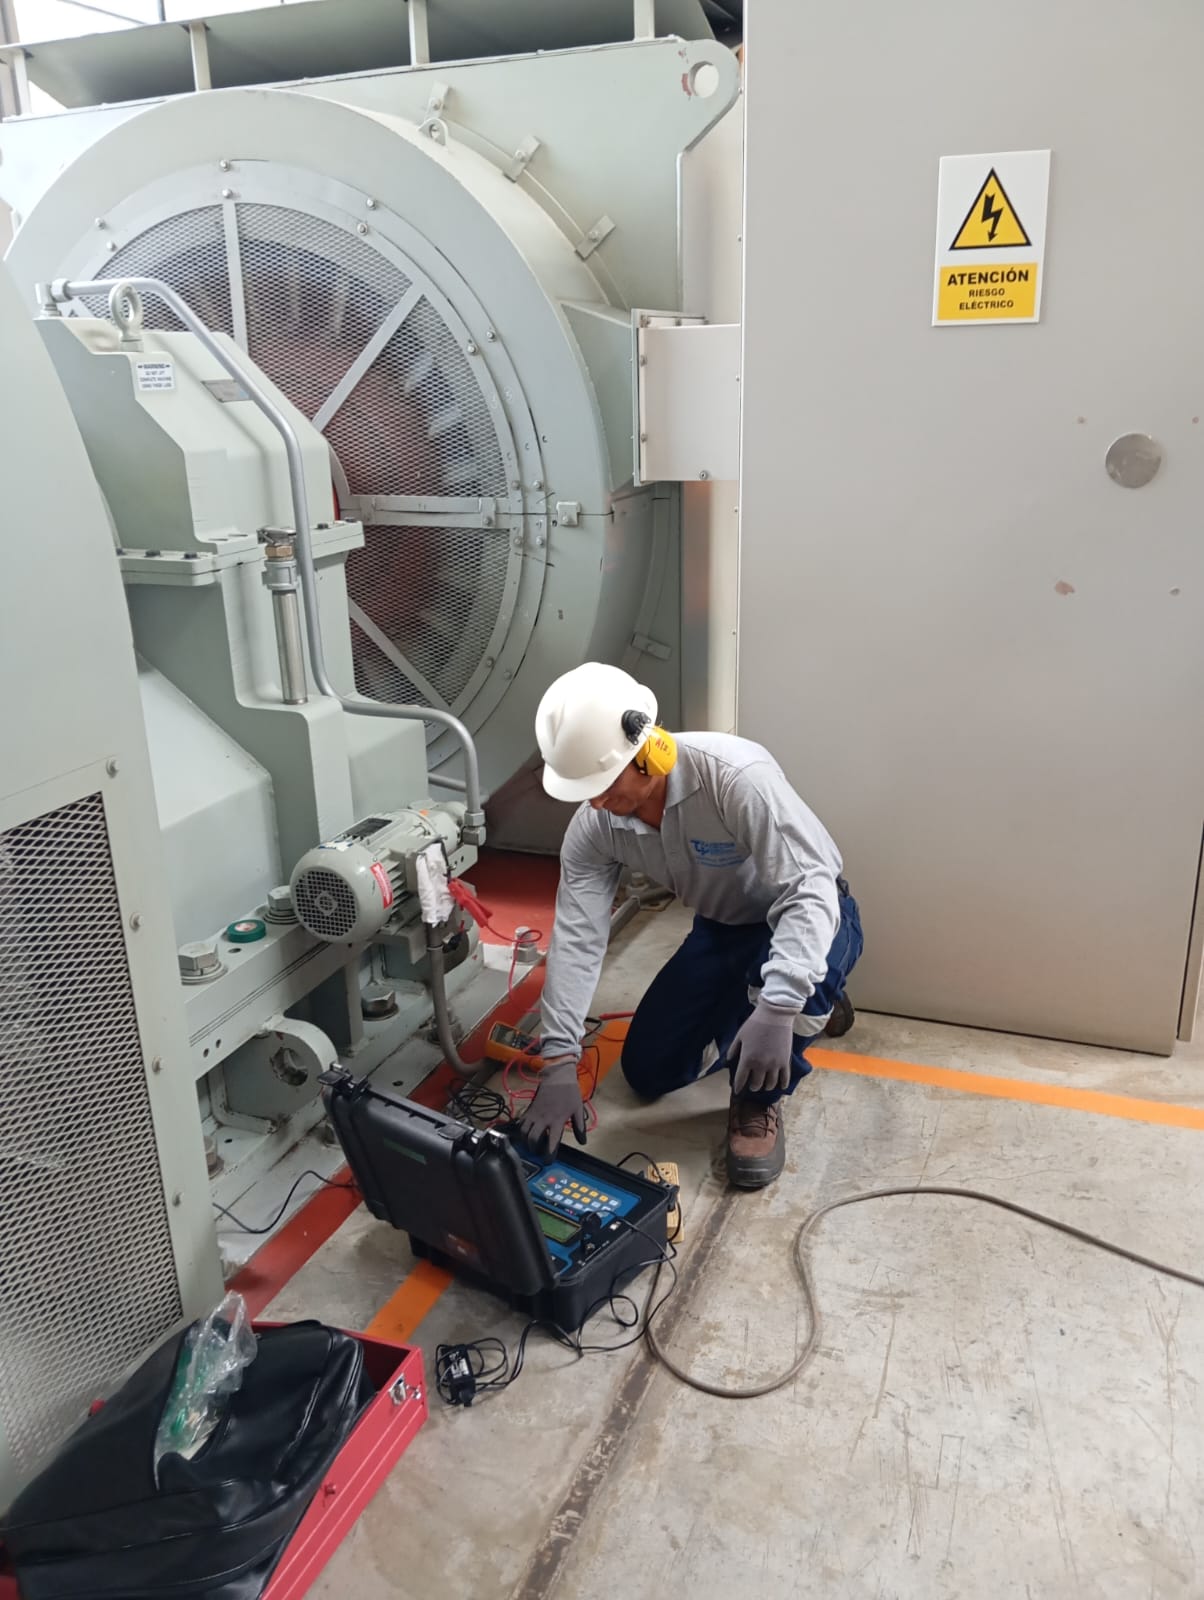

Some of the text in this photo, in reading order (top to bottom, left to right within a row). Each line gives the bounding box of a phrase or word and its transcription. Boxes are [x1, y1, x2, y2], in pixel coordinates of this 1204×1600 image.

[947, 267, 1029, 286] ATENCIÓN
[968, 288, 1005, 298] RIESGO
[959, 299, 1014, 310] ELÉCTRICO
